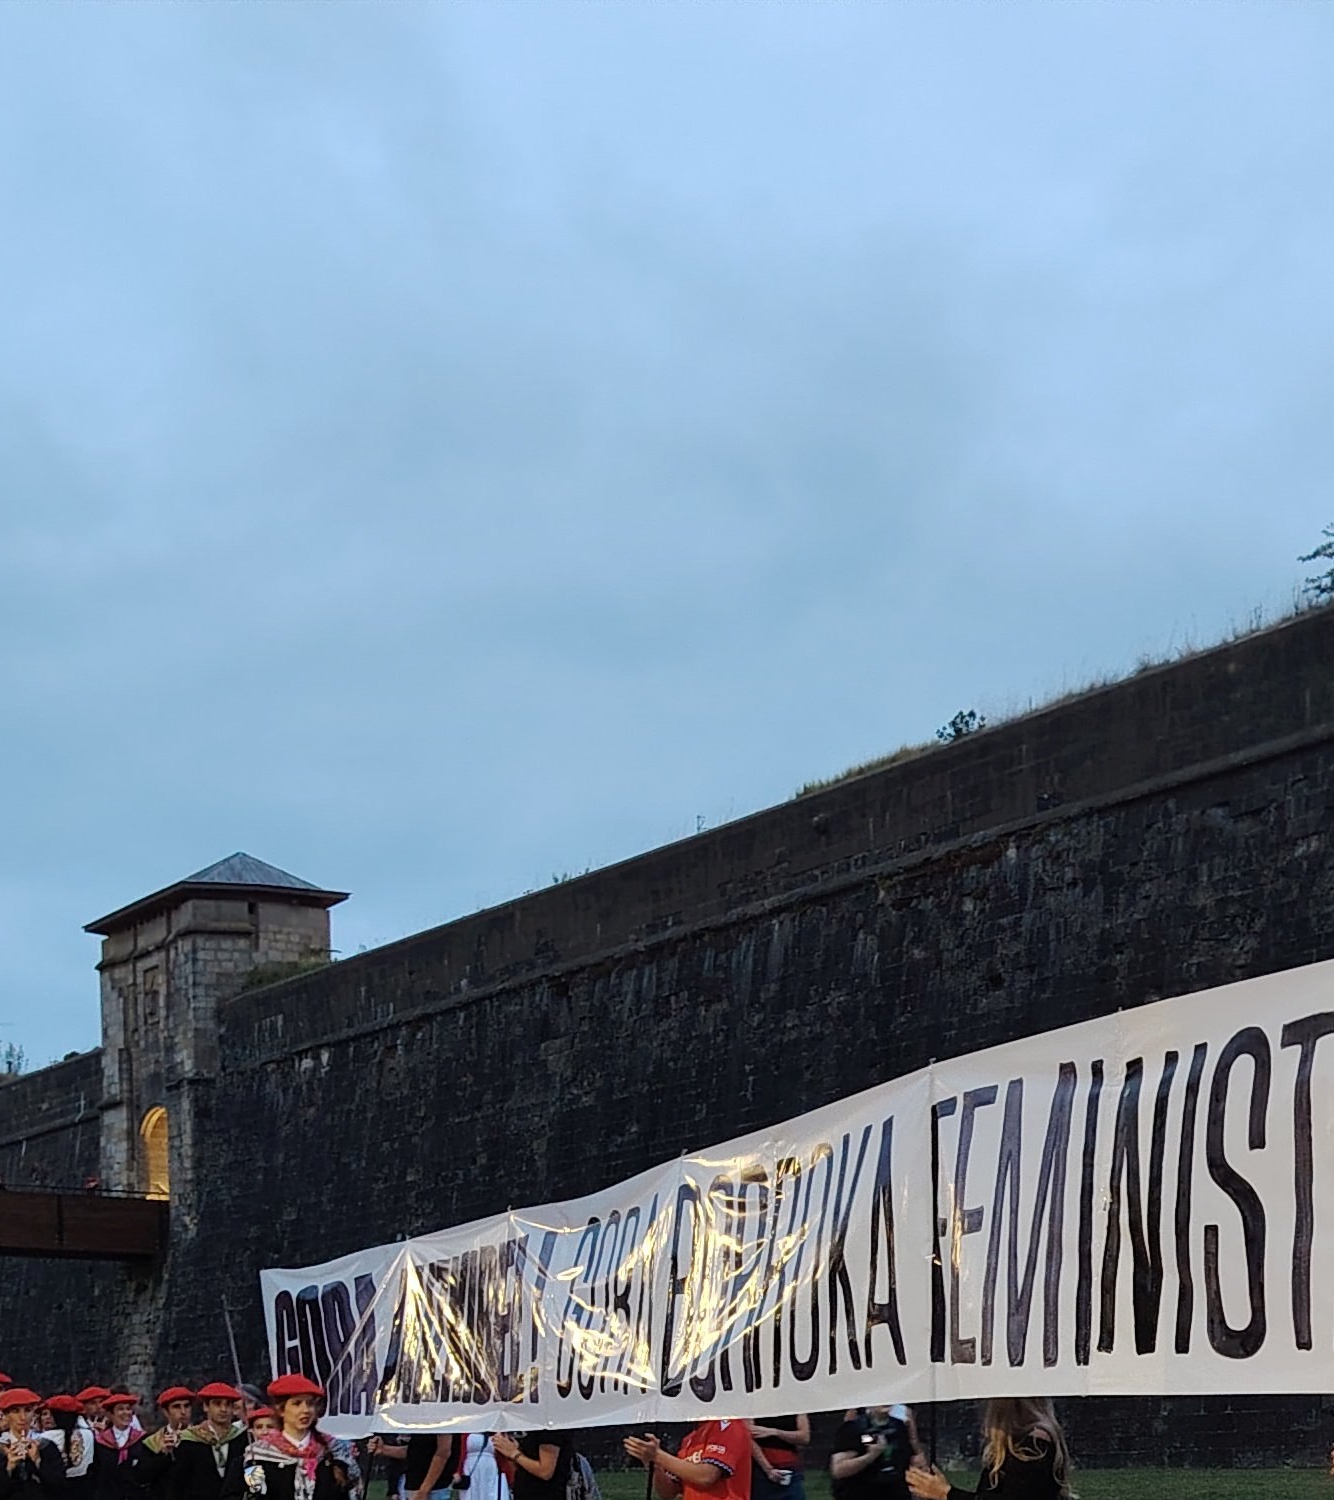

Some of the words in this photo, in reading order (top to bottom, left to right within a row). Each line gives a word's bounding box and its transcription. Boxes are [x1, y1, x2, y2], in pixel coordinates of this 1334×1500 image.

[273, 1273, 378, 1417] GORA
[556, 1193, 659, 1401] GORA
[660, 1115, 907, 1403] BORROKA
